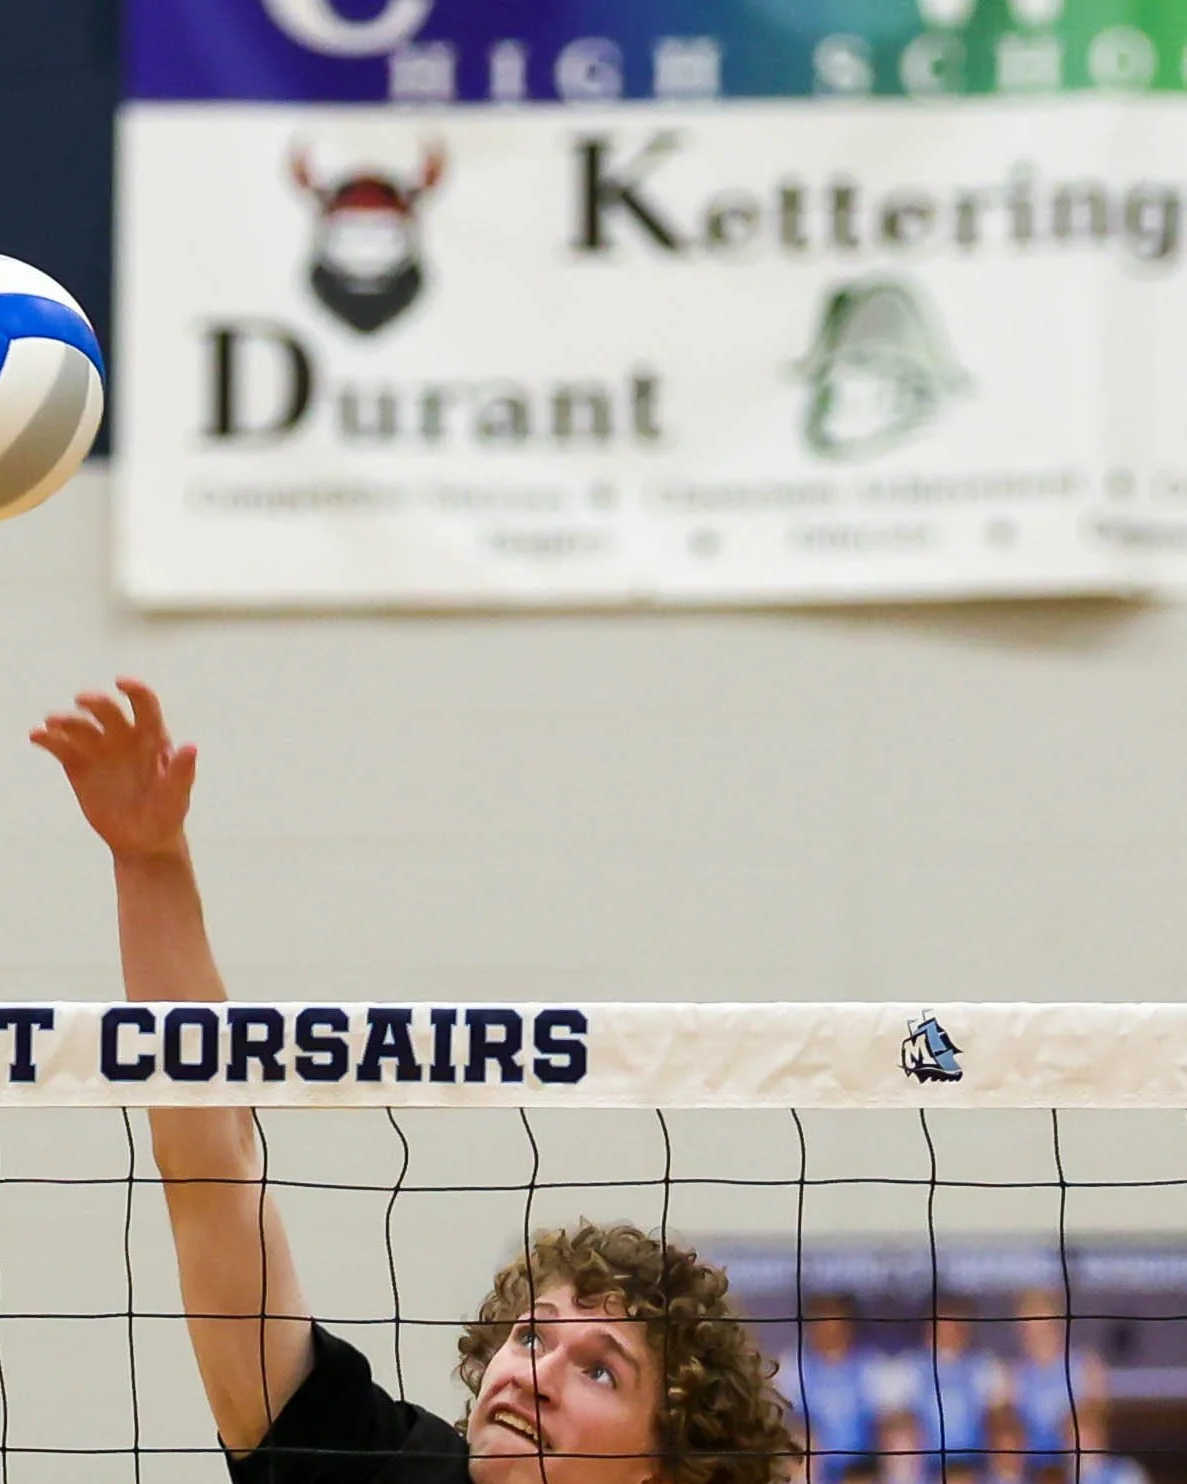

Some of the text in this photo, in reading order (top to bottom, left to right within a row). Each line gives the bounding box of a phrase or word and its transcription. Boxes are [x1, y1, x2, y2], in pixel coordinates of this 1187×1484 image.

[815, 27, 1187, 100] SCHO
[570, 129, 1184, 274] Kettering
[199, 315, 665, 447] Durant
[100, 1007, 590, 1084] CORSAIRS
